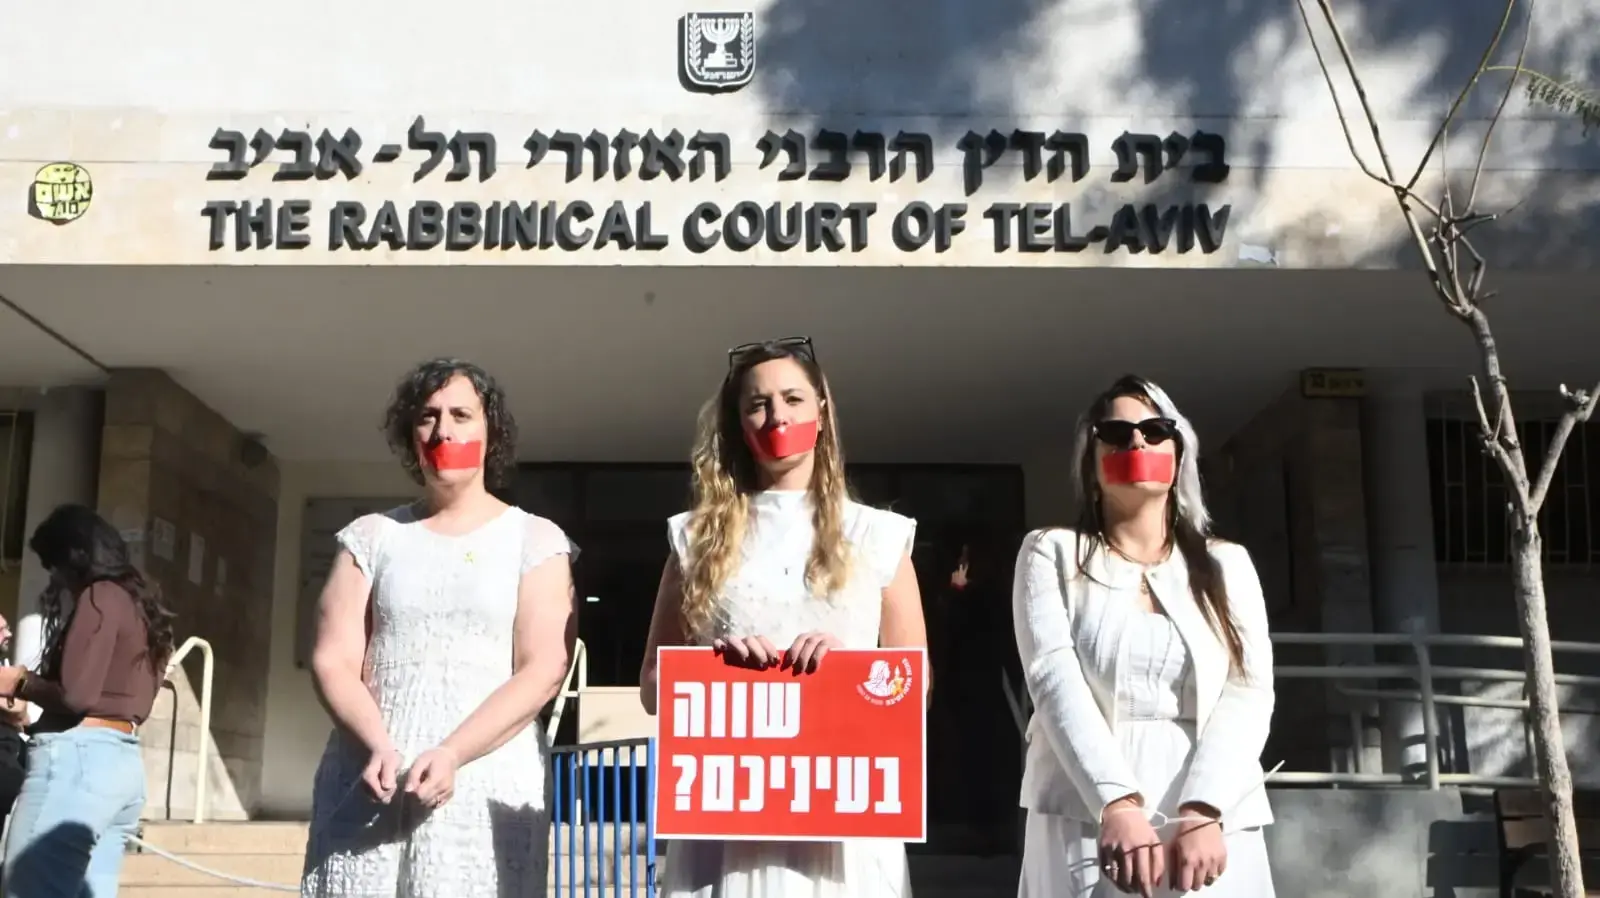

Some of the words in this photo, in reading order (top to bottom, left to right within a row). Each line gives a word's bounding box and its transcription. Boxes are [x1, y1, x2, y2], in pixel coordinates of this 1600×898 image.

[523, 127, 732, 183] האזורי
[756, 127, 933, 183] הרבני
[956, 128, 1090, 197] הדין
[1110, 129, 1230, 183] בית
[200, 198, 312, 251] THE
[328, 200, 669, 252] RABBINICAL
[683, 200, 877, 253] COURT
[892, 200, 968, 253] OF
[983, 202, 1232, 255] TEL-AVIV
[673, 681, 801, 739] שווה
[671, 754, 902, 814] בעיניכם?
